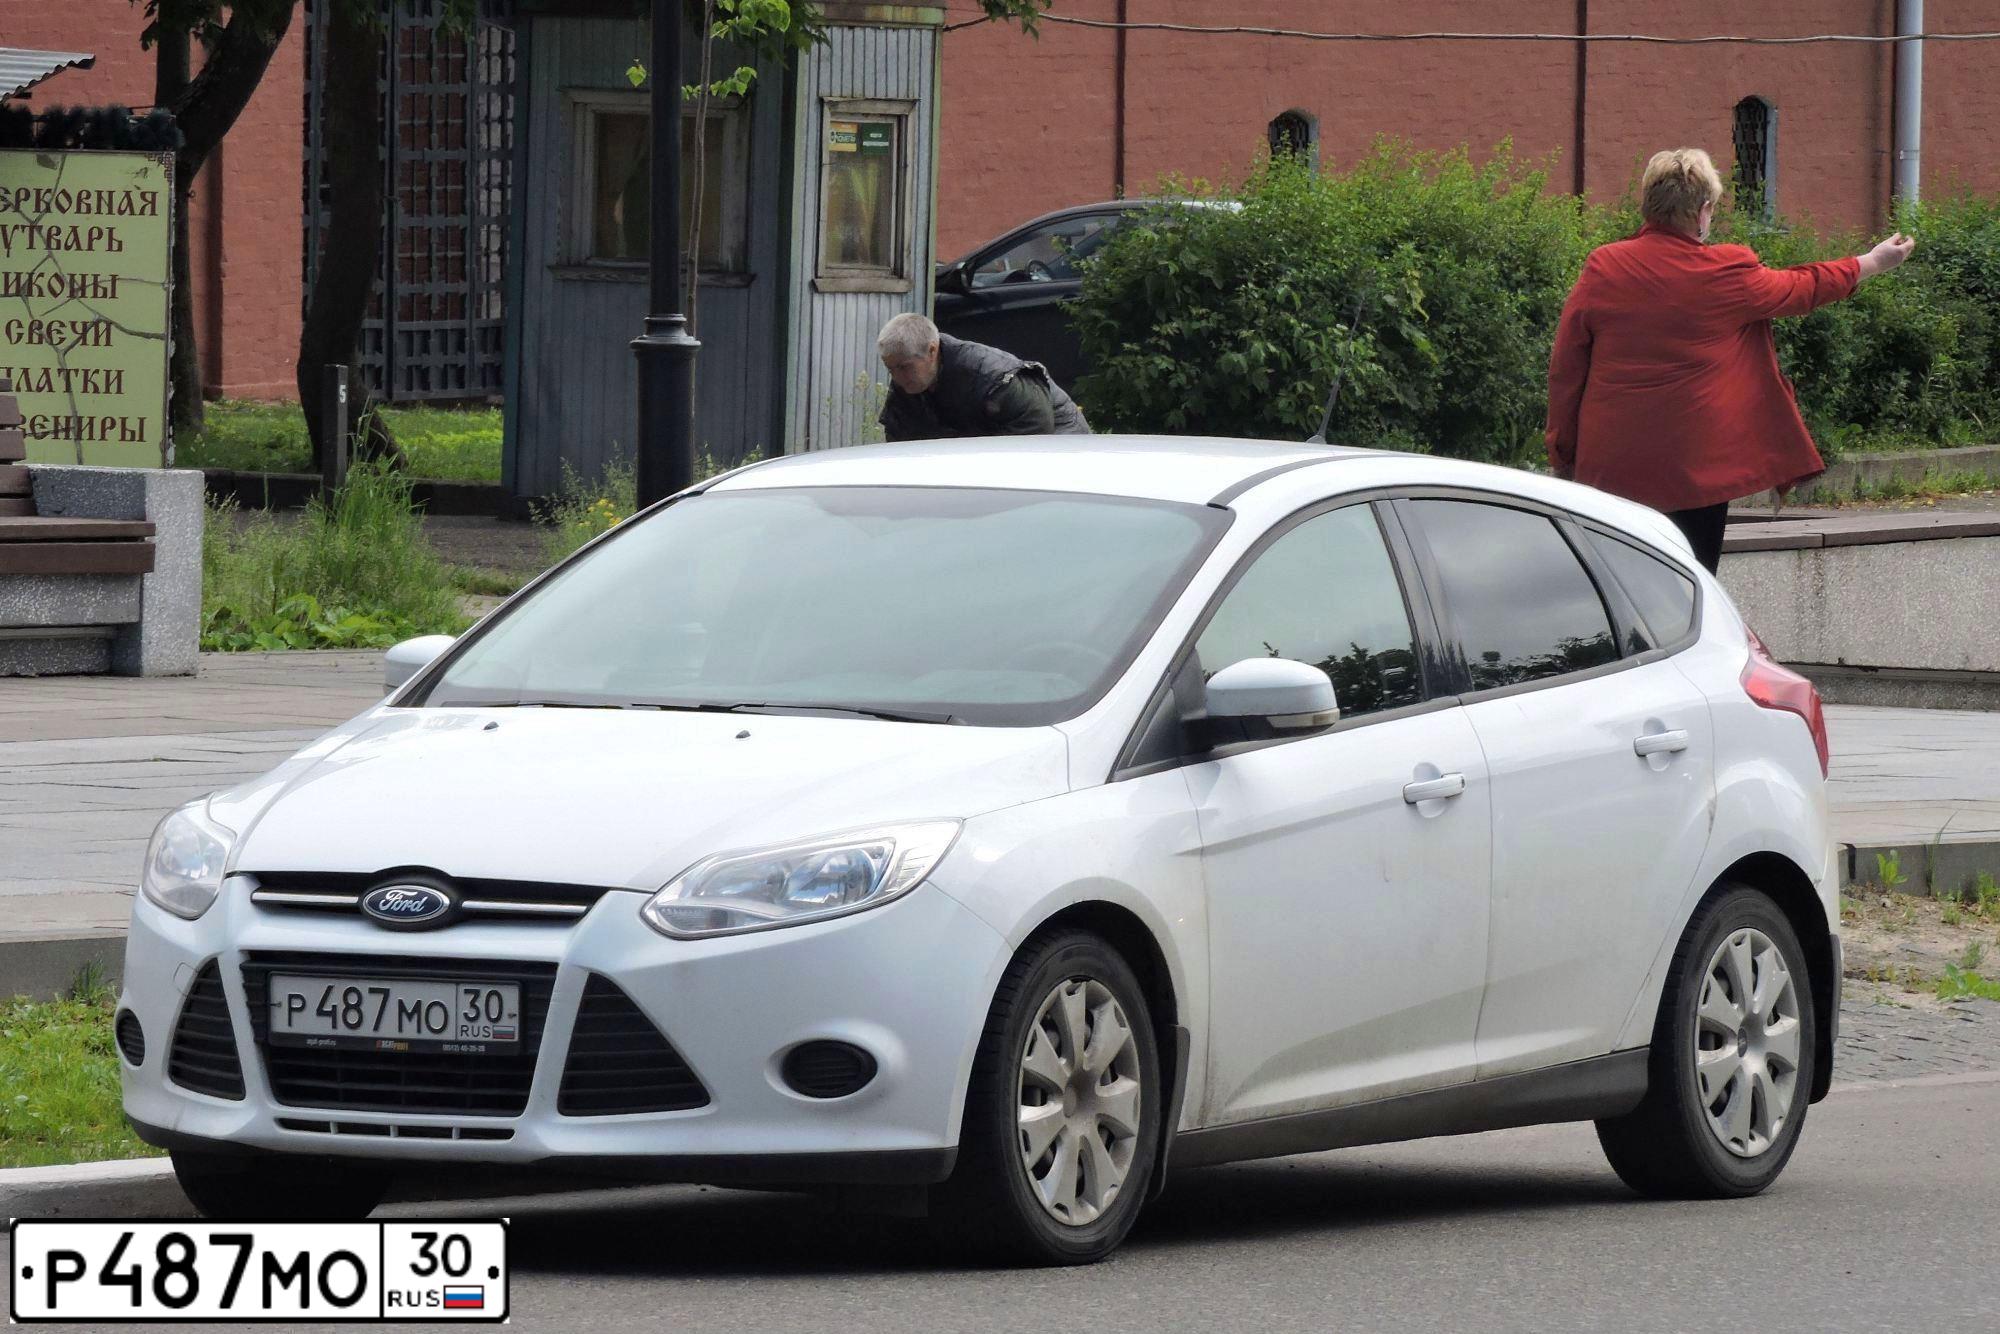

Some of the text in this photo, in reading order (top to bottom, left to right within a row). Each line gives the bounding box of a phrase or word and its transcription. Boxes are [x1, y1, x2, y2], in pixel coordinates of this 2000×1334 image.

[0, 224, 123, 258] УТВАРЬ
[2, 271, 119, 299] ИКОНЫ
[5, 319, 113, 347] СВЕЧИ
[339, 384, 346, 403] 5
[379, 889, 428, 912] Ford
[463, 988, 503, 1023] 30
[460, 1024, 491, 1038] RUS
